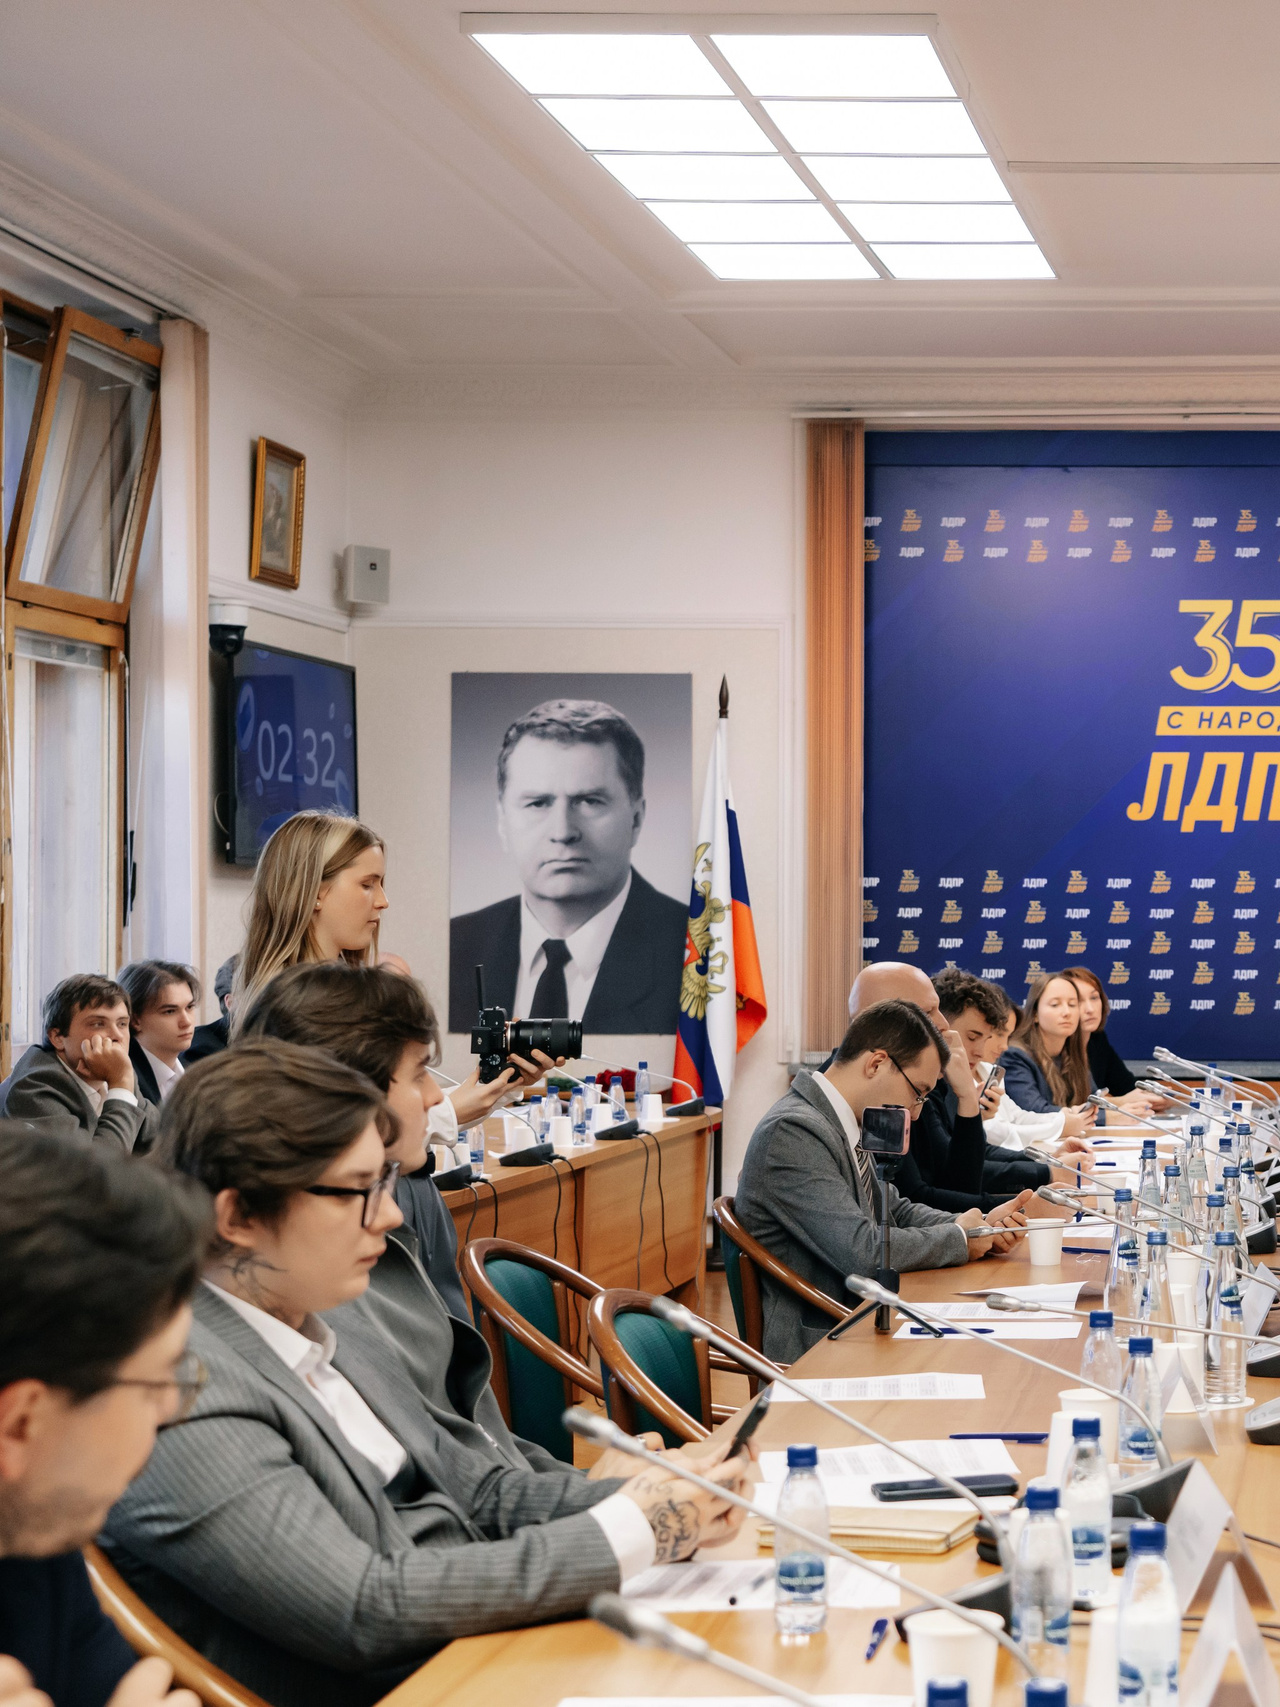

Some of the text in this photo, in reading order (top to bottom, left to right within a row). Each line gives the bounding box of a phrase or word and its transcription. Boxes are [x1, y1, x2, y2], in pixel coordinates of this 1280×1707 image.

[864, 516, 882, 527] ДПР
[1167, 711, 1184, 729] С
[902, 870, 914, 880] 35
[986, 870, 998, 880] 35
[1070, 871, 1082, 881] 35
[1154, 871, 1166, 881] 35
[1238, 871, 1250, 881] 35
[862, 877, 880, 888] ДПР
[938, 878, 964, 889] ЛДПР
[1022, 878, 1047, 889] ЛДПР
[1106, 878, 1131, 889] ЛДПР
[1190, 878, 1216, 889] ЛДПР
[944, 901, 956, 911] 35
[1029, 901, 1041, 911] 35
[1113, 901, 1125, 911] 35
[1197, 901, 1209, 911] 35
[897, 907, 922, 919] ЛДПР
[981, 908, 1006, 919] ЛДПР
[1065, 908, 1090, 919] ЛДПР
[1149, 909, 1174, 920] ЛДПР
[1233, 909, 1258, 920] ЛДПР
[902, 931, 914, 941] 35
[985, 931, 997, 941] 35
[1069, 931, 1081, 941] 35
[1153, 931, 1165, 941] 35
[1238, 931, 1250, 941] 35
[862, 938, 880, 949] ДПР
[938, 938, 963, 949] ЛДПР
[1022, 938, 1047, 949] ЛДПР
[1106, 939, 1131, 950] ЛДПР
[1190, 939, 1215, 950] ЛДПР
[1028, 961, 1040, 971] 35
[1113, 962, 1125, 972] 35
[1197, 962, 1209, 972] 35
[982, 968, 1006, 979] ЛДПР
[1149, 969, 1174, 980] ЛДПР
[1232, 969, 1258, 980] ЛДПР
[1153, 992, 1165, 1002] 35
[1237, 992, 1249, 1002] 35
[1190, 1000, 1215, 1011] ЛДПР
